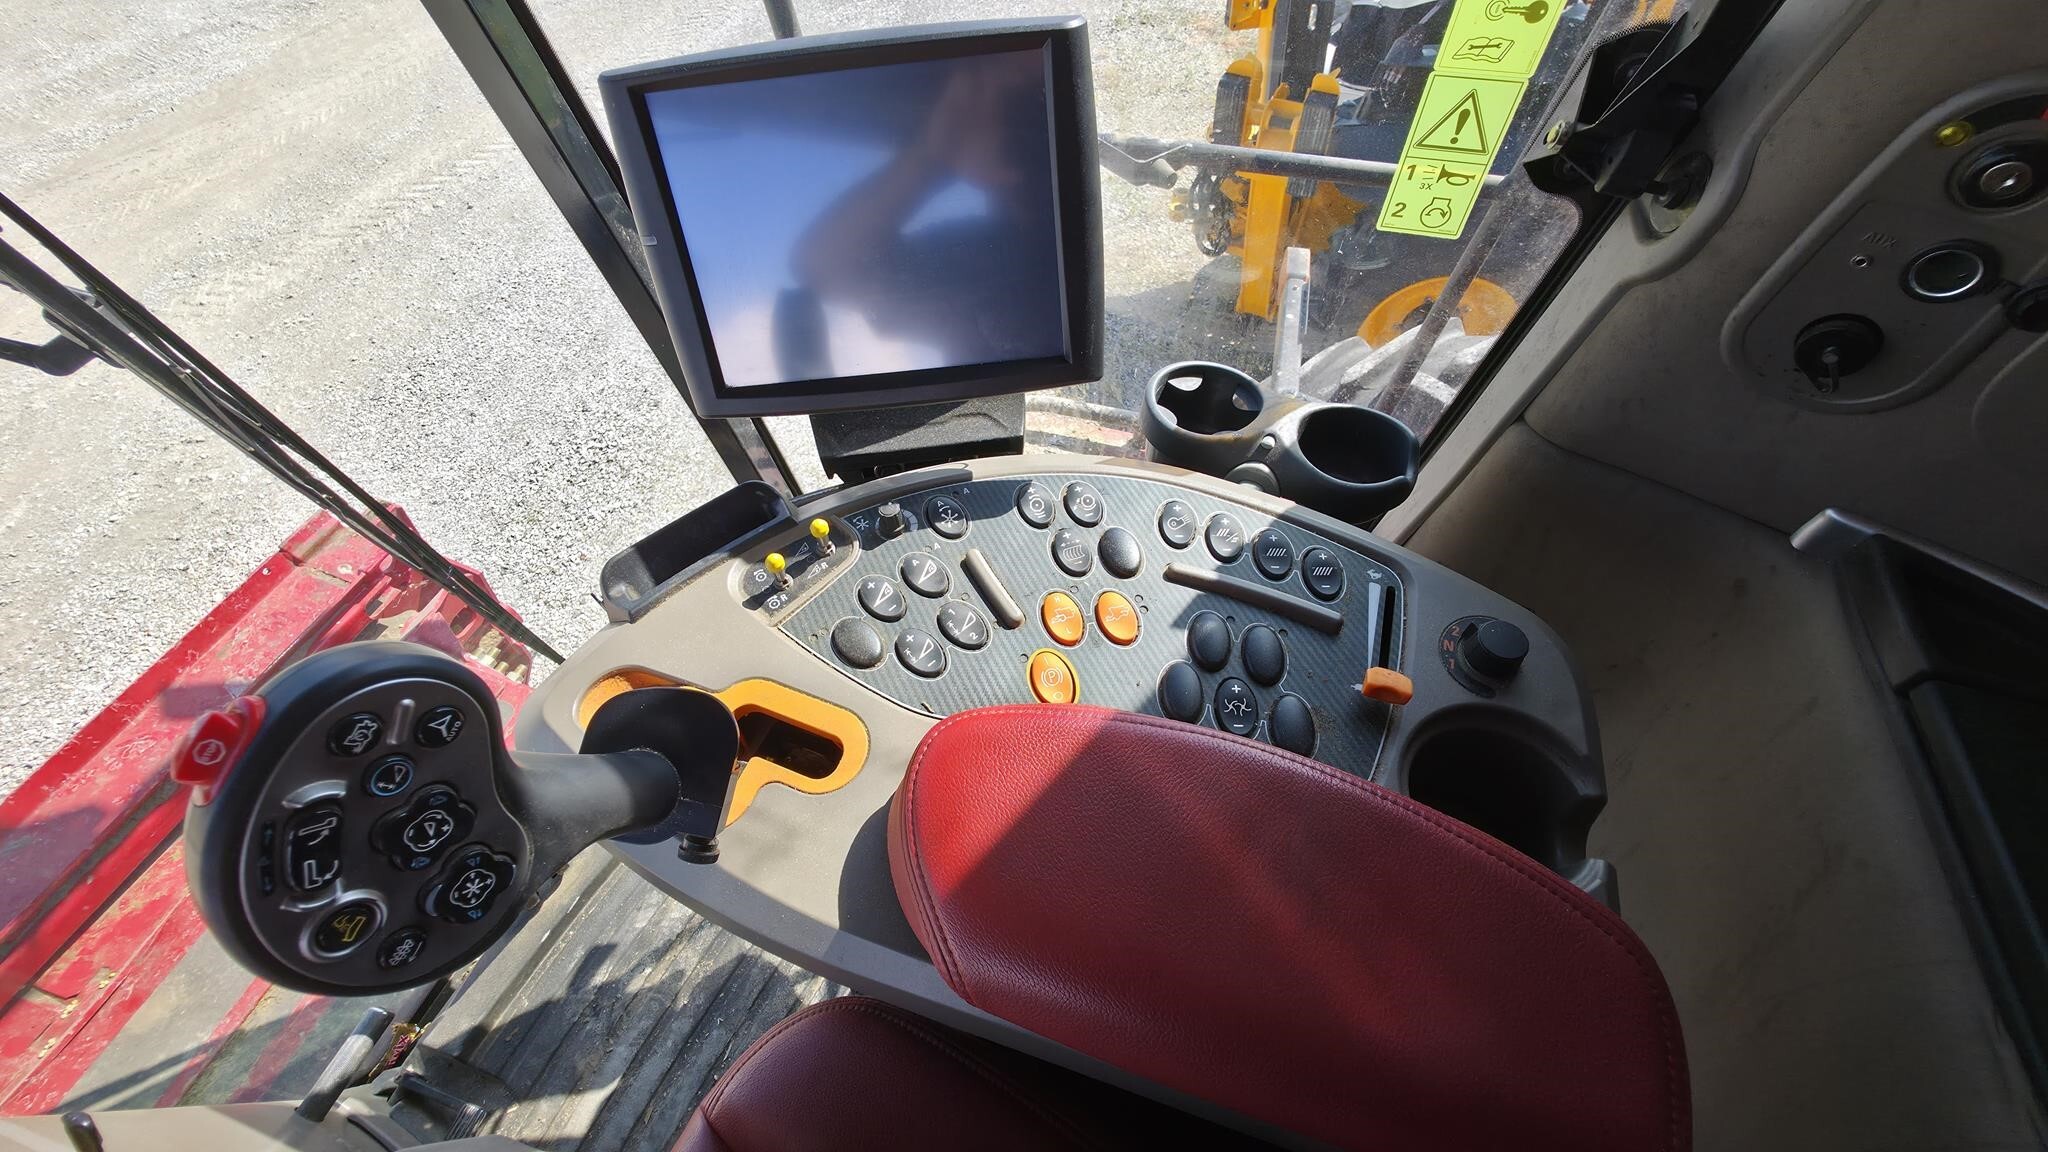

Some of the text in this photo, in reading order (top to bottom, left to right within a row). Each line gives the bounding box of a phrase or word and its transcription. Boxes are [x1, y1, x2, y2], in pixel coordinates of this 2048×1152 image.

[1406, 164, 1417, 181] 1
[1391, 202, 1407, 218] 2
[1862, 231, 1897, 249] AUX
[1451, 625, 1460, 637] 2
[1443, 639, 1454, 652] N
[445, 720, 462, 742] AUTO
